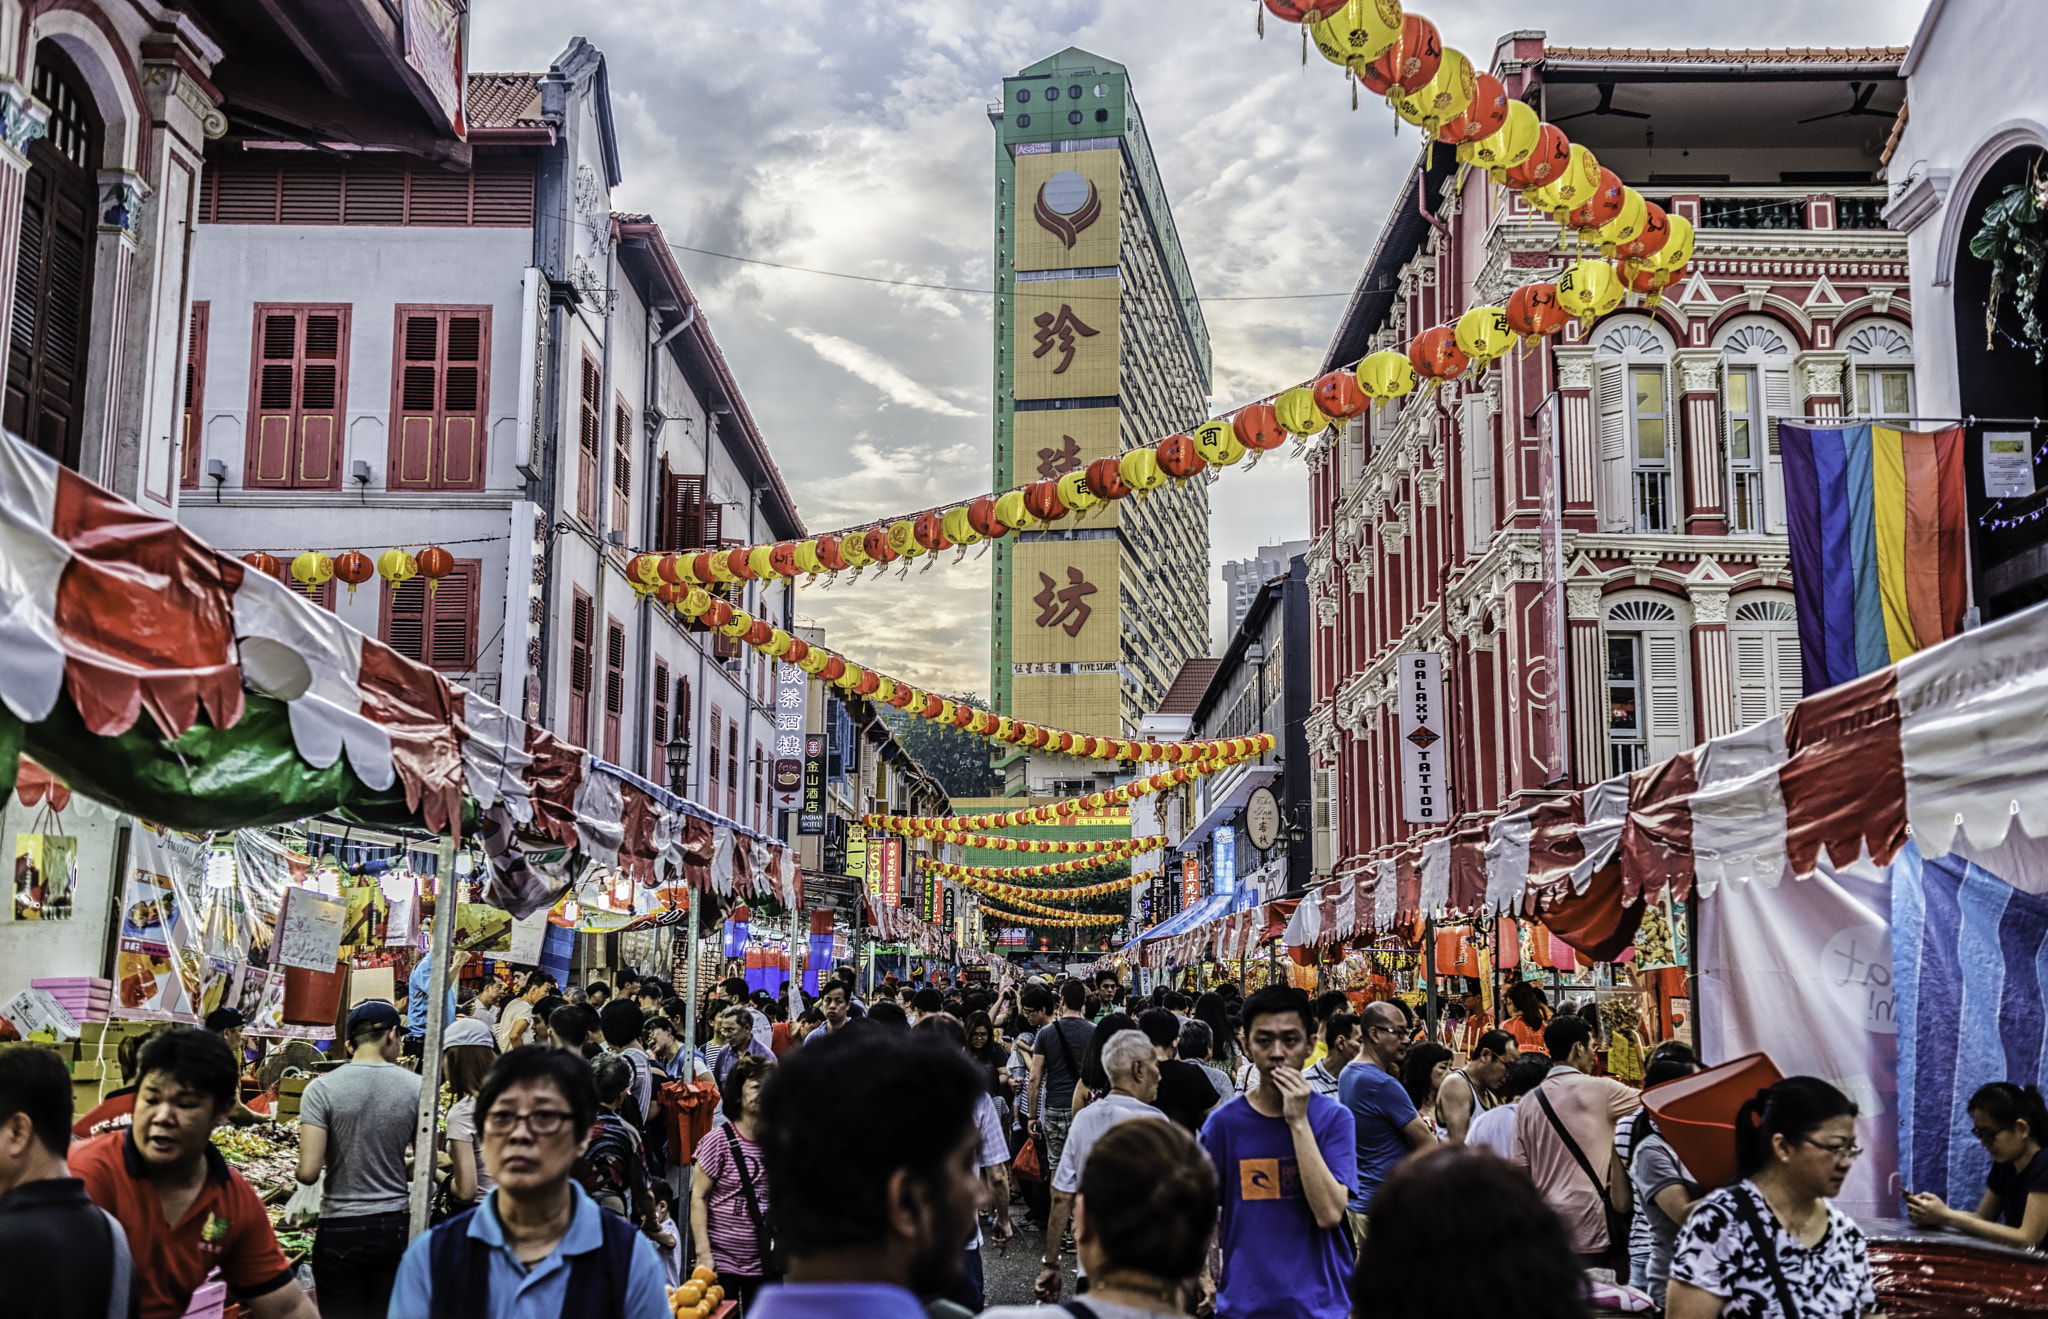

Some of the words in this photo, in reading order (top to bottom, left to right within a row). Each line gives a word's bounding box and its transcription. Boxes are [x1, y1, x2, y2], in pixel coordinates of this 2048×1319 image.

[1080, 663, 1095, 671] FIVE
[1096, 662, 1117, 671] STARS
[1414, 659, 1428, 724] GALAXY
[777, 664, 803, 756] 飲茶酒樓
[806, 760, 819, 813] 金山酒店
[1418, 751, 1433, 817] TATTOO
[870, 851, 881, 895] Spa
